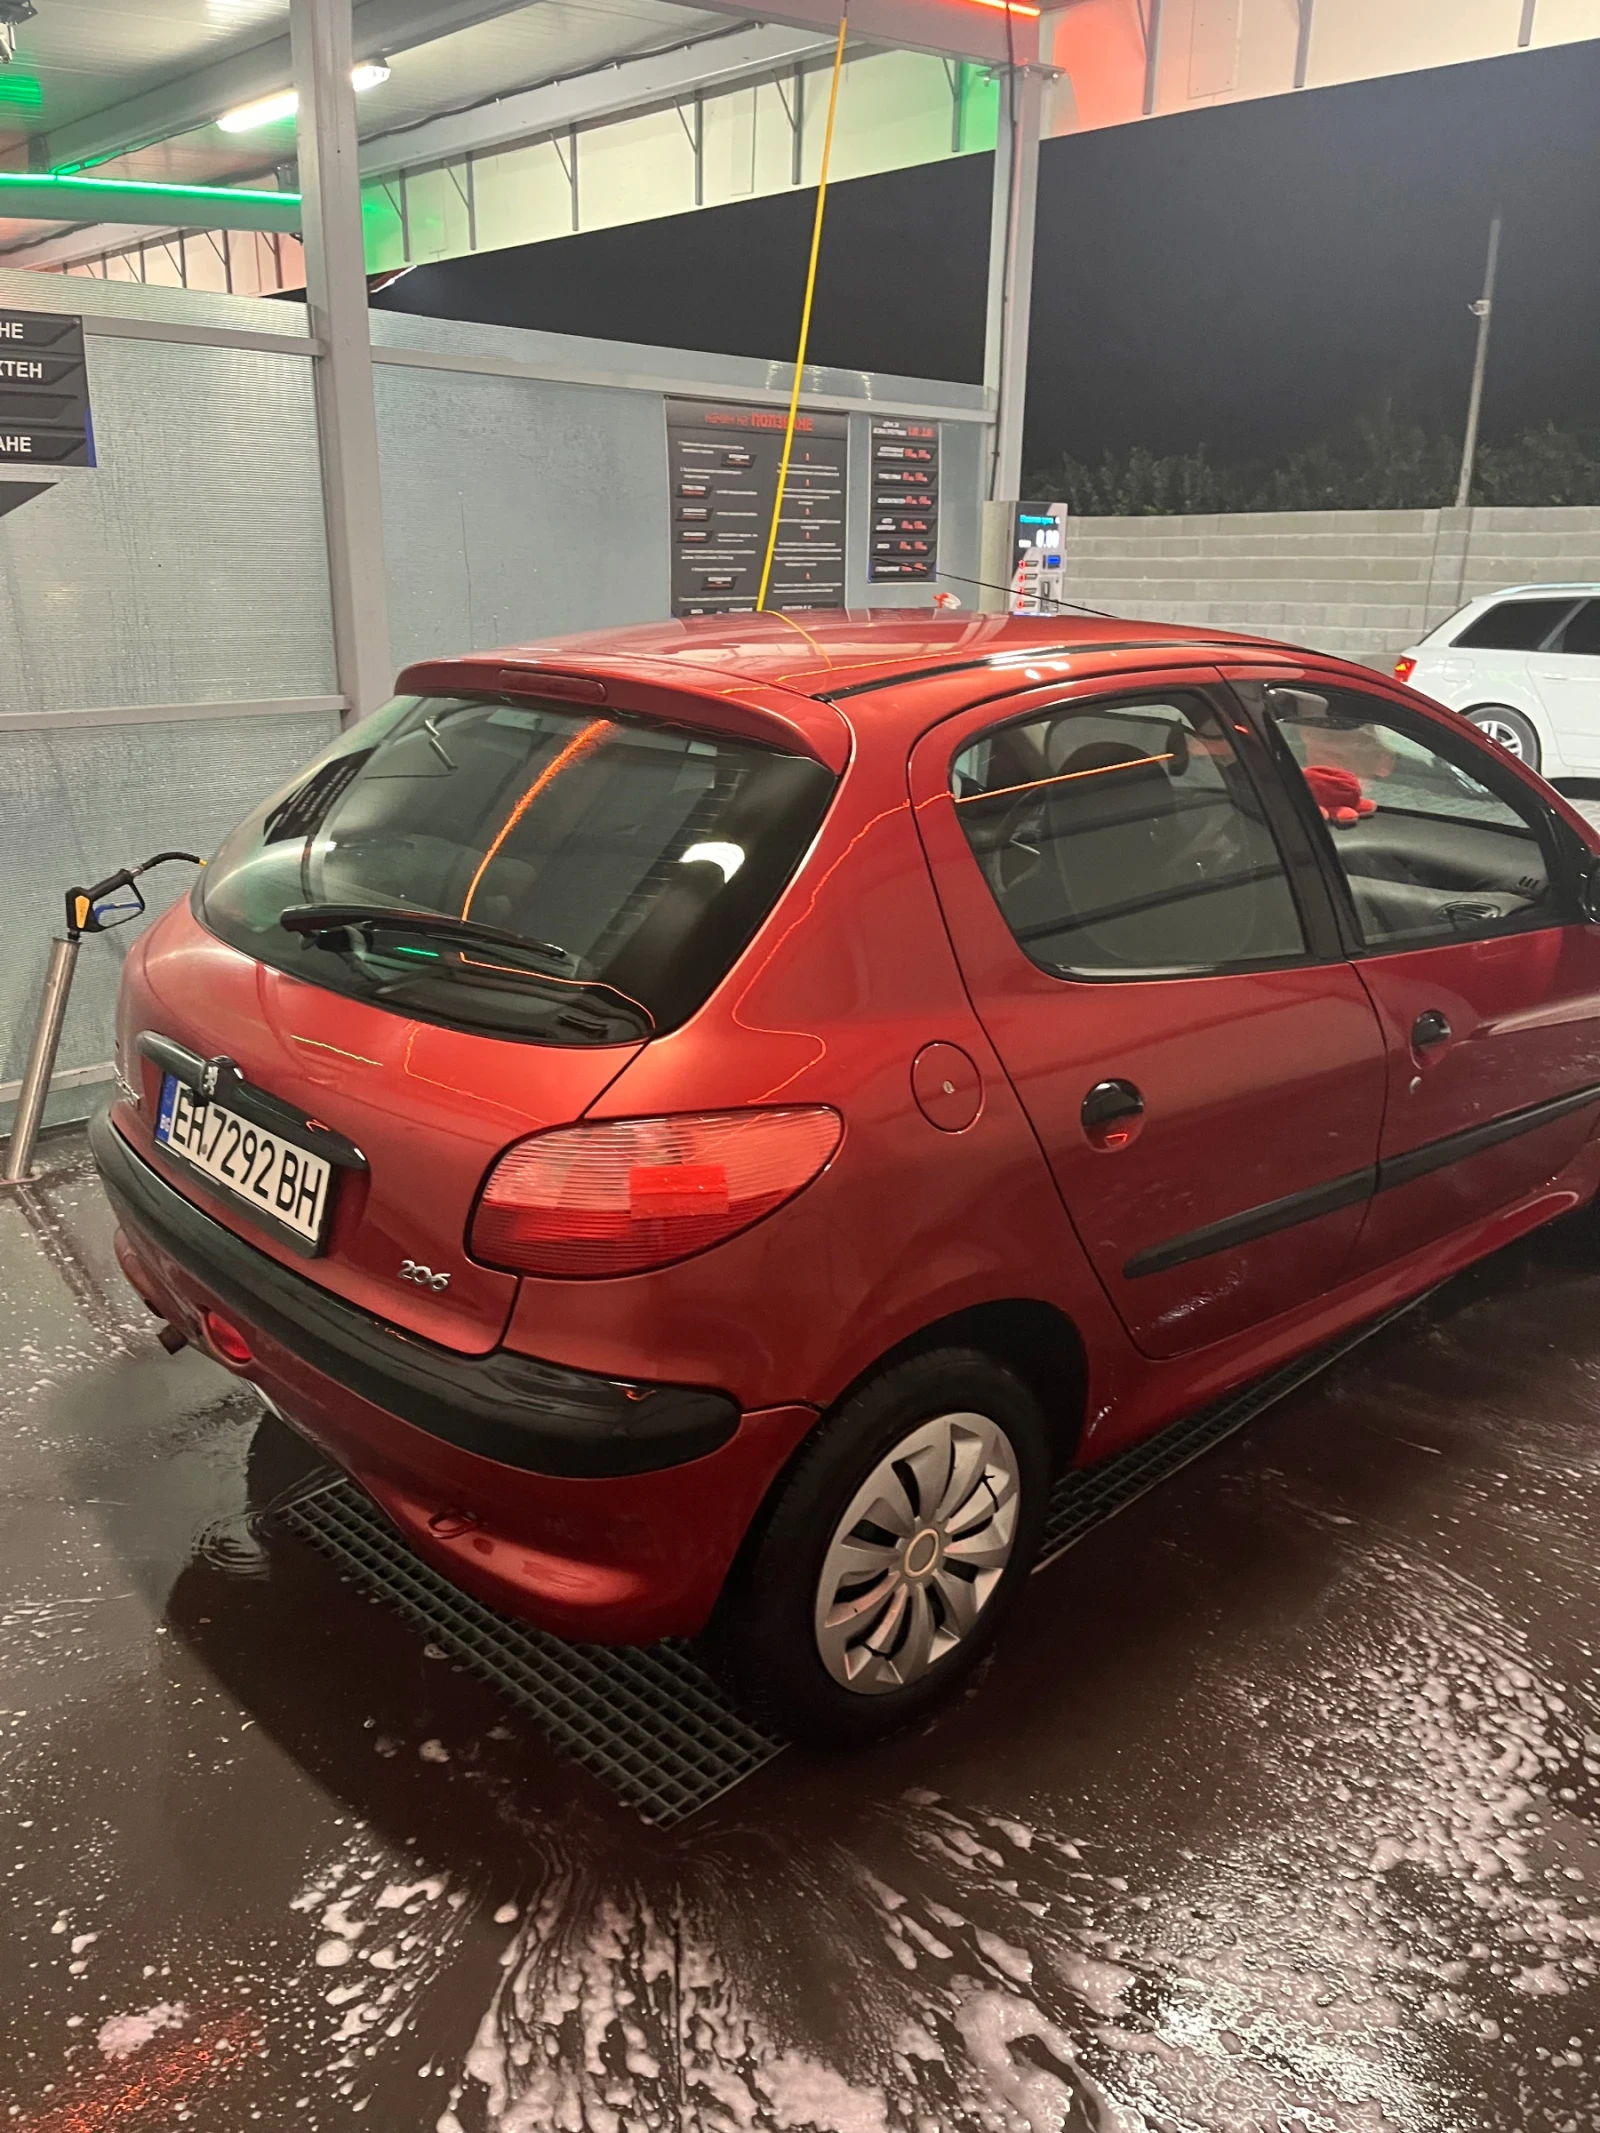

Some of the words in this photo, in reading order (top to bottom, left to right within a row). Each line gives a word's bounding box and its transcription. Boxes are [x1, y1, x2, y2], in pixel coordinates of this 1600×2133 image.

[206, 1108, 276, 1200] 7292
[275, 1149, 323, 1228] BH
[398, 1259, 451, 1292] 206
